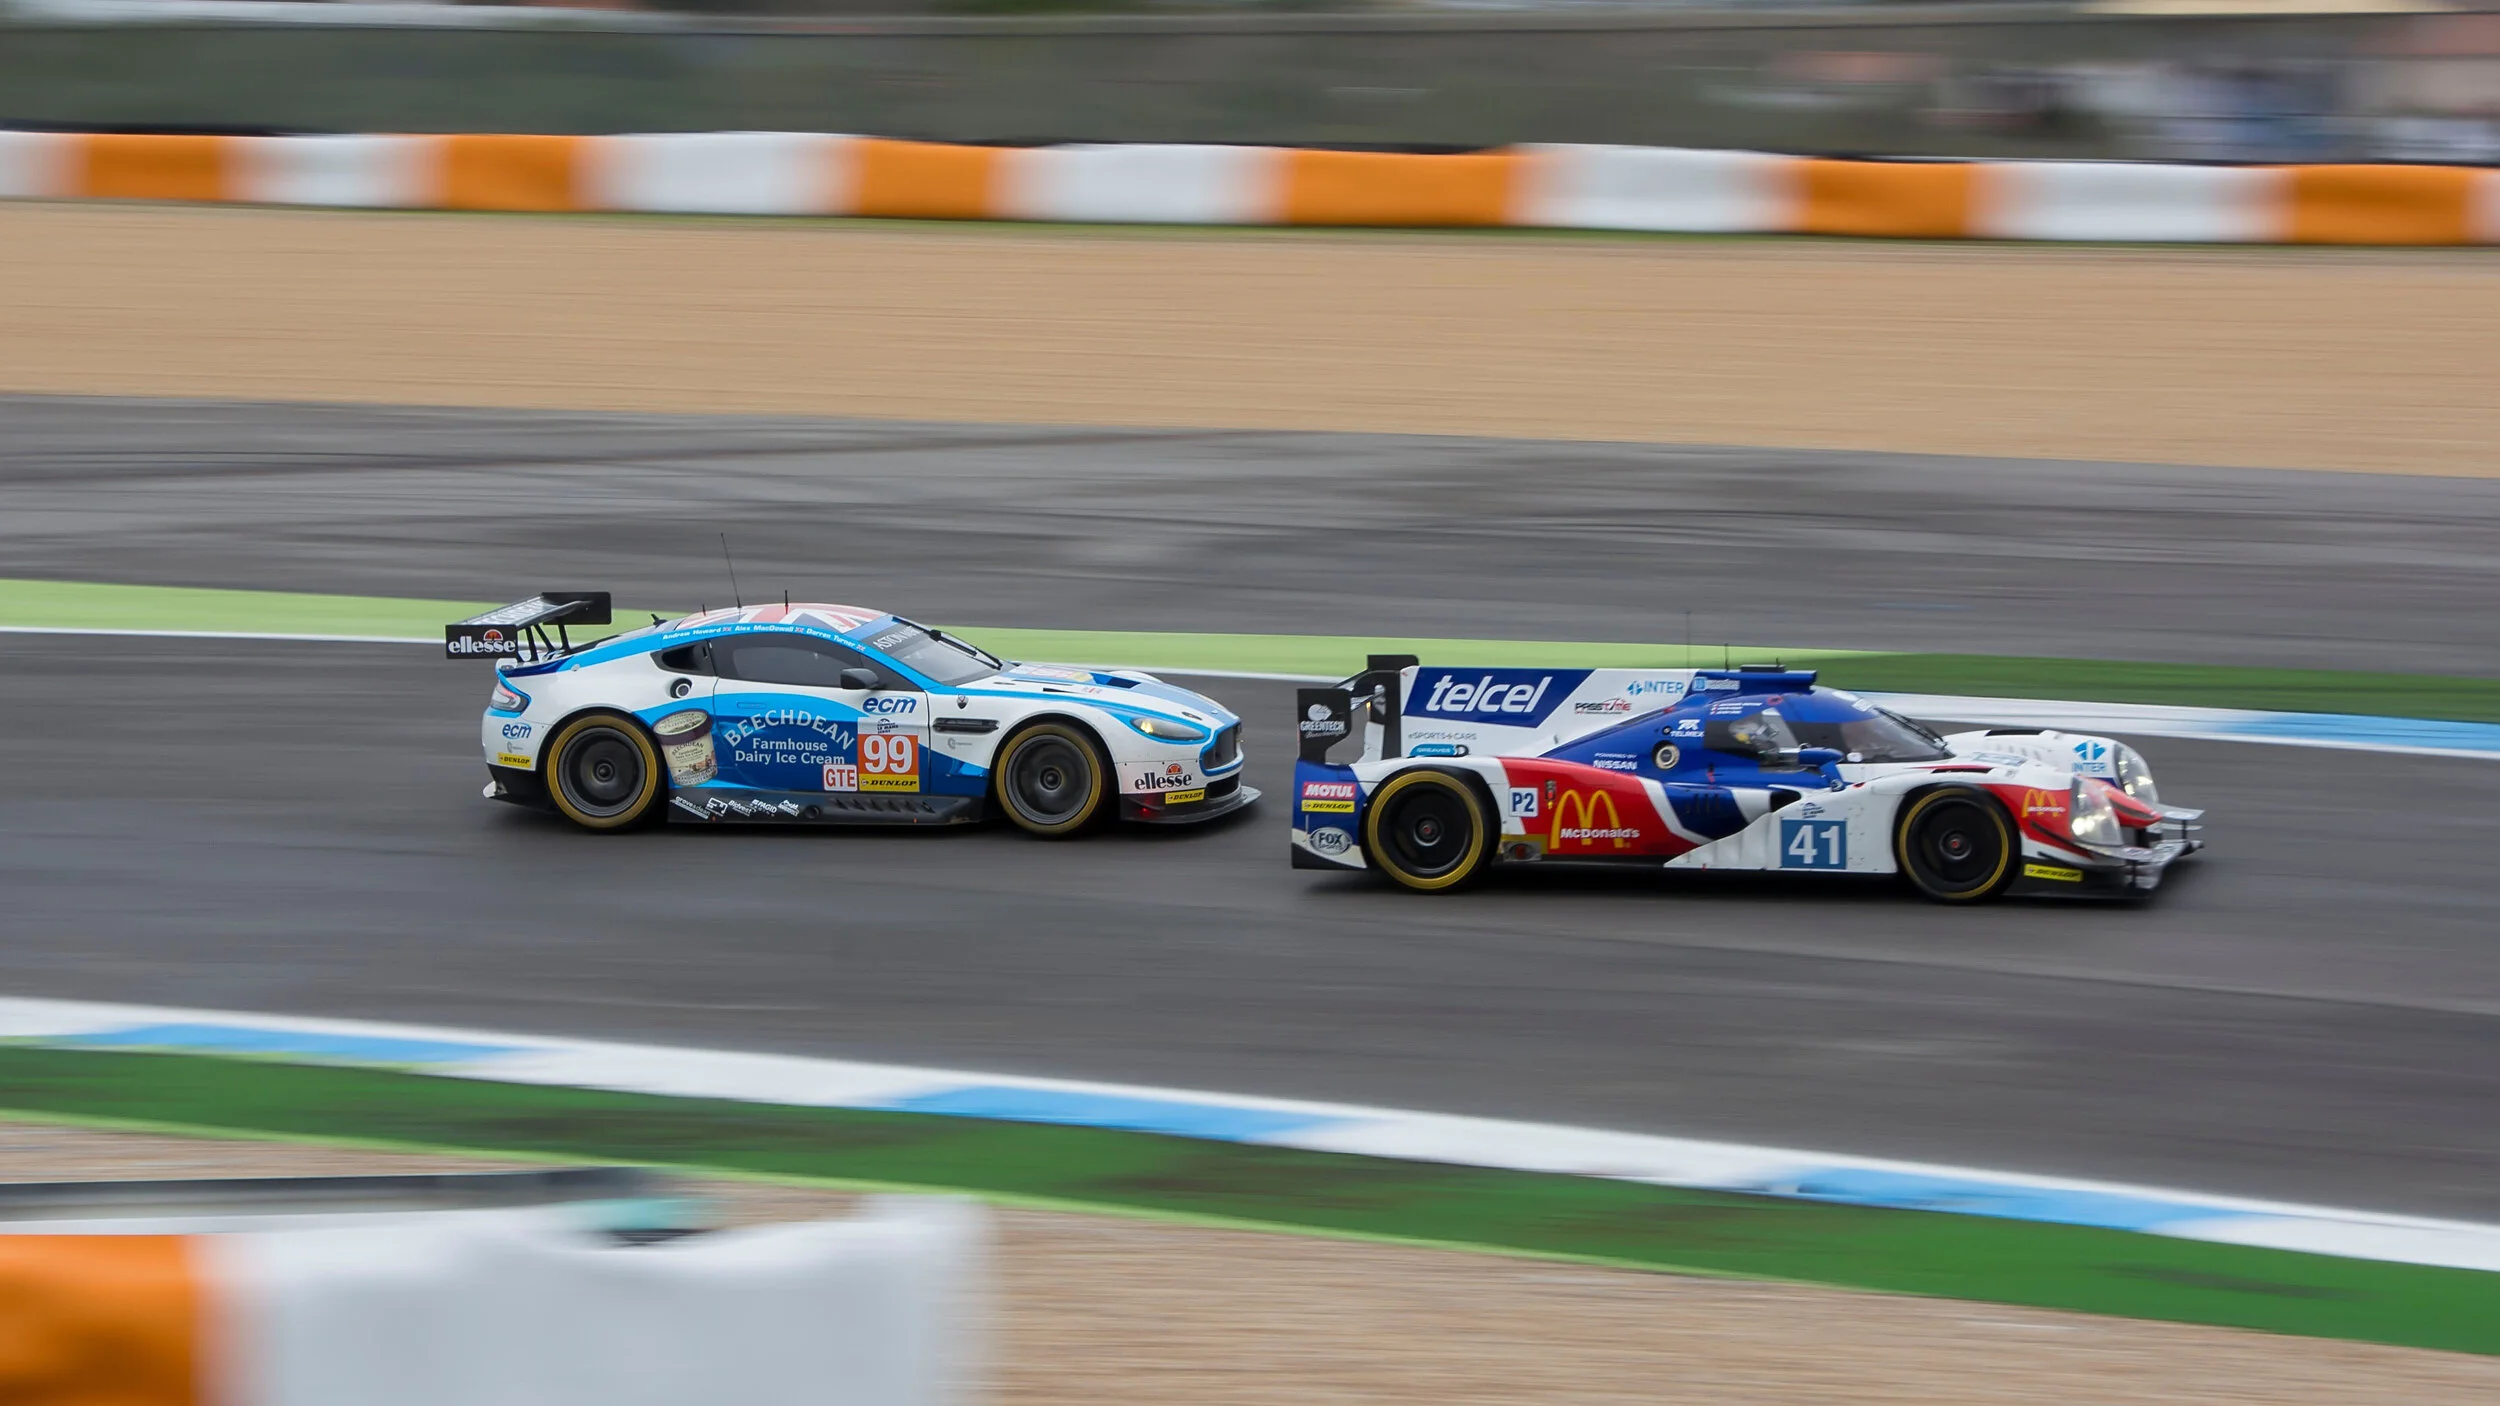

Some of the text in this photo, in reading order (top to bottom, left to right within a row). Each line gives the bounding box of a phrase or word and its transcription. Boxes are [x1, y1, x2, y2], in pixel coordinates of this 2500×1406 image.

[448, 636, 516, 653] ellesse
[693, 627, 721, 635] Howard
[806, 628, 831, 639] Darren
[834, 635, 856, 647] Turner
[873, 632, 908, 650] ASTON
[1426, 675, 1553, 713] telcel
[1643, 681, 1684, 694] INTER
[862, 696, 917, 714] ecm
[502, 722, 532, 739] ecm
[723, 709, 855, 750] BEECHDEAN
[1300, 720, 1345, 732] GREENTECH
[752, 738, 828, 751] Farmhouse
[502, 756, 531, 764] DUNLOP
[735, 750, 845, 765] Dairy Ice Cream
[863, 735, 913, 774] 99
[1593, 760, 1638, 771] NISSAN
[826, 768, 856, 787] GTE
[1134, 771, 1193, 790] ellesse
[1173, 792, 1203, 801] DUNLOP
[1305, 784, 1354, 797] MOTUL
[728, 799, 752, 815] Bidvest
[757, 801, 778, 814] PAGID
[1512, 792, 1535, 812] P2
[1318, 832, 1345, 845] FOX
[1560, 828, 1640, 838] McDonald's
[1788, 824, 1840, 865] 41
